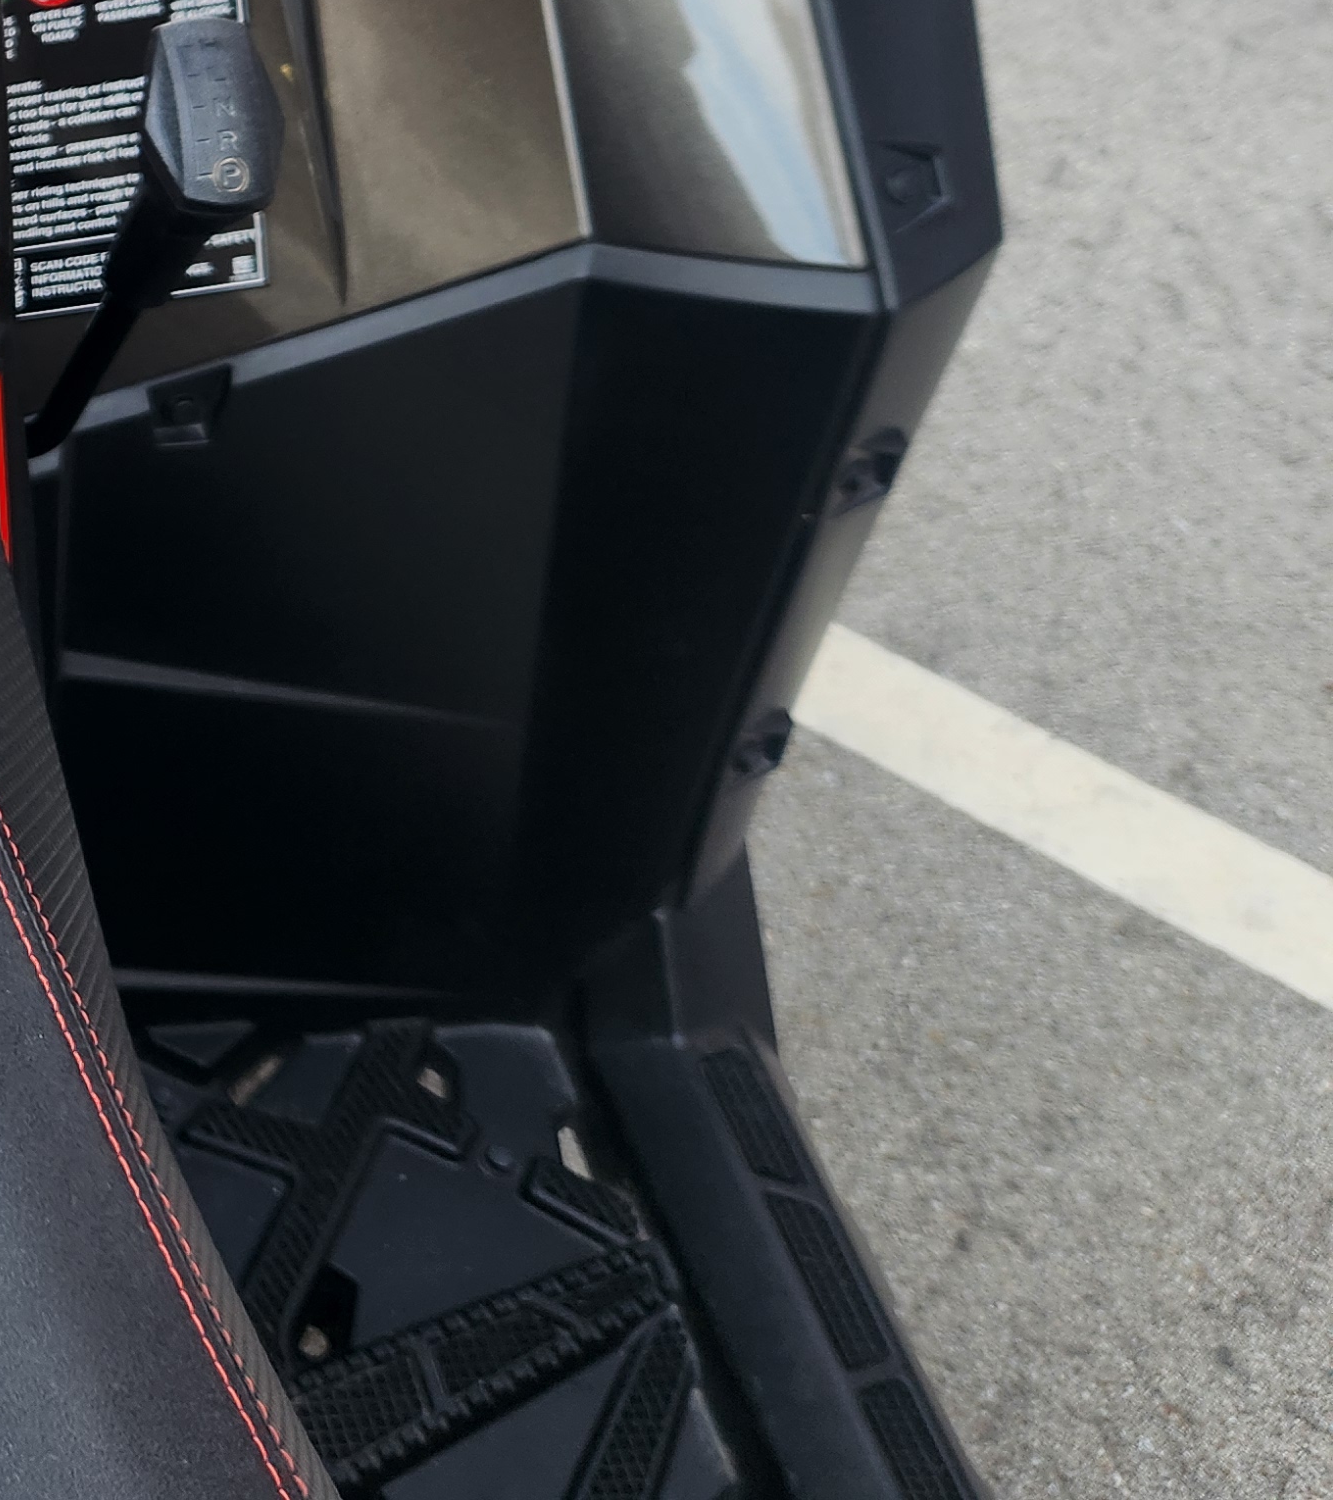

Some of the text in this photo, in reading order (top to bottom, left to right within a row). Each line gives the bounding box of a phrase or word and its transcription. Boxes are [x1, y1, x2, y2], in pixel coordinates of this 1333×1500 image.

[29, 4, 84, 22] NEVER USE
[32, 17, 83, 33] ON PUBLIC
[41, 30, 76, 43] ROADS
[44, 86, 86, 102] training
[18, 101, 77, 120] too fast for
[67, 109, 114, 125] collision
[9, 133, 50, 147] vehicle
[65, 134, 129, 155] passengers
[217, 129, 239, 151] R
[13, 151, 104, 174] and increase risk
[31, 184, 64, 197] riding
[65, 175, 126, 192] techniques
[41, 193, 89, 209] hills and
[39, 207, 88, 222] surfaces
[54, 215, 118, 234] and control
[30, 259, 63, 273] SCAN
[64, 252, 101, 267] CODE
